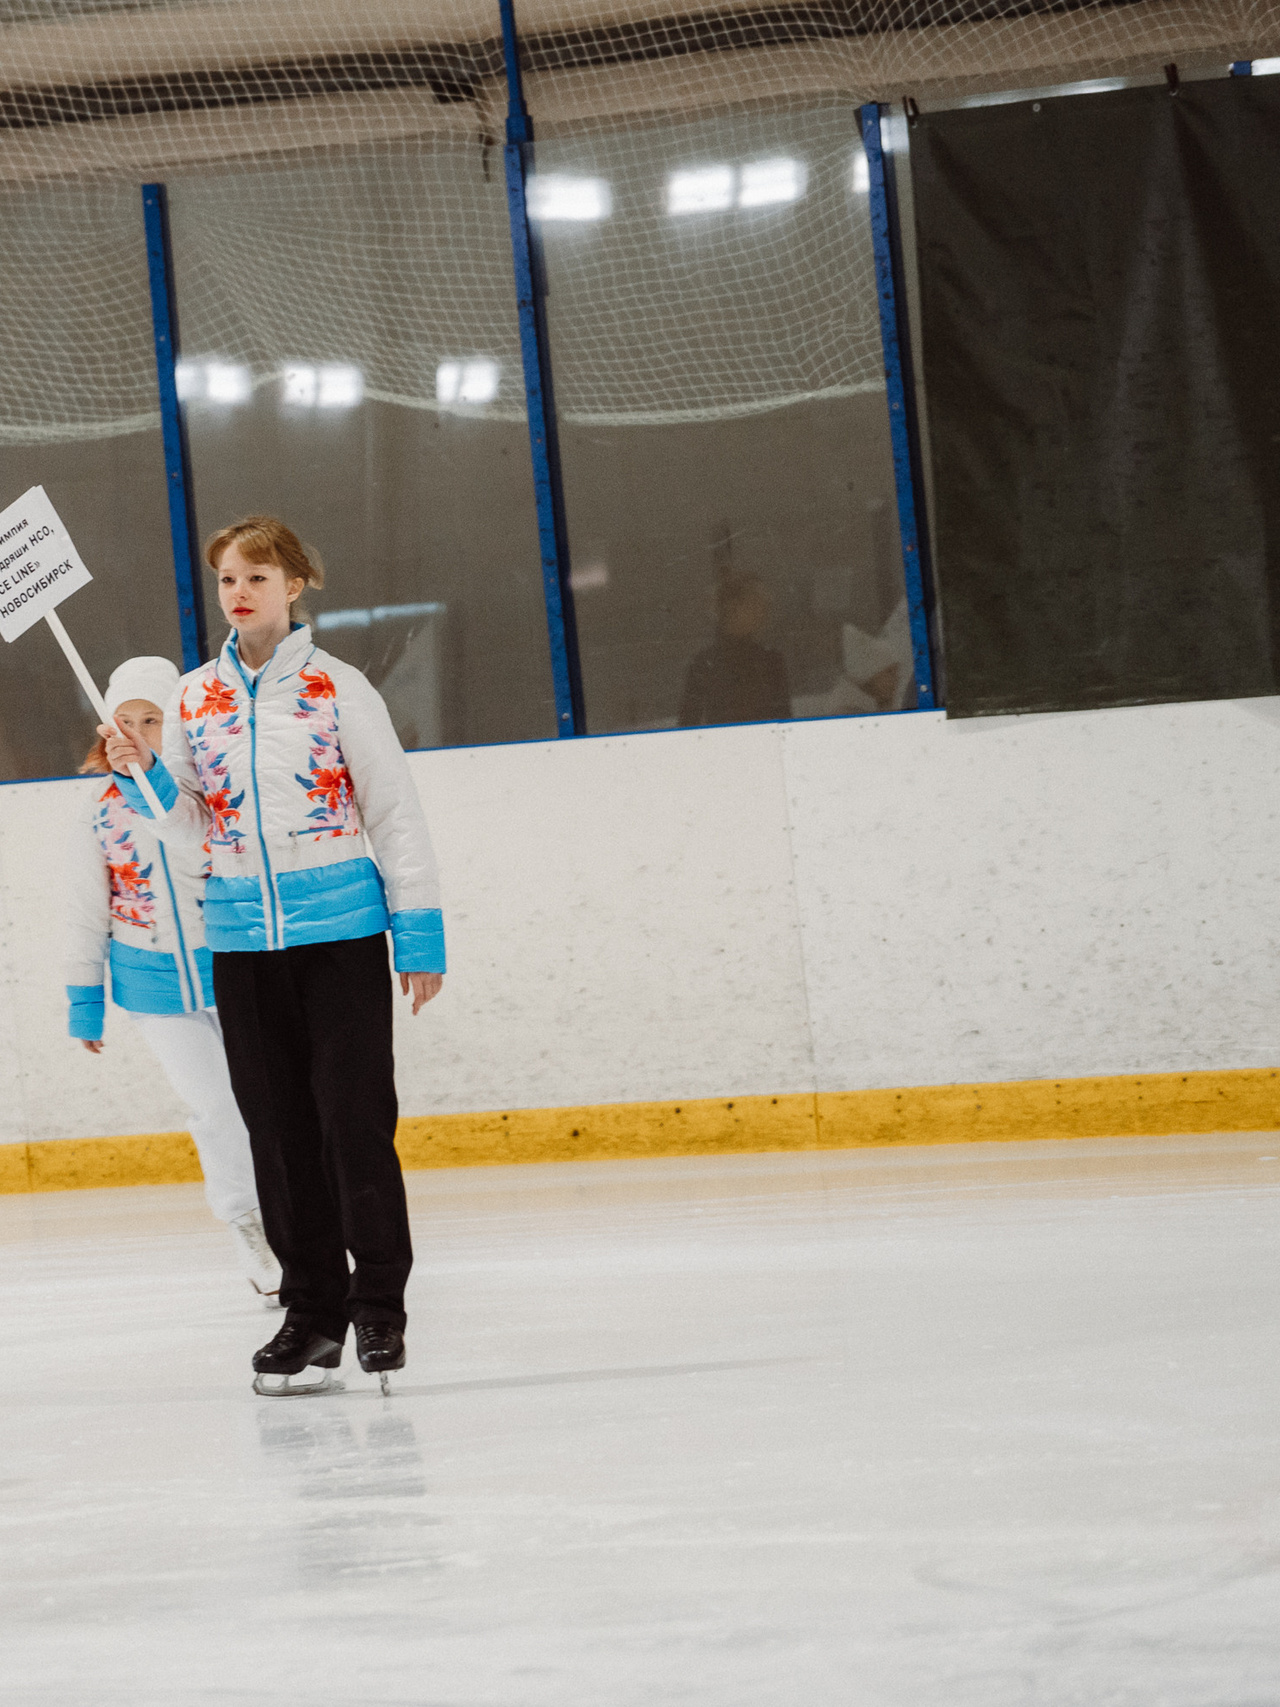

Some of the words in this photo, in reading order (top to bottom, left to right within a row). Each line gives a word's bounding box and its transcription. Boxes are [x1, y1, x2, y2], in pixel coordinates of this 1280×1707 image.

[28, 525, 55, 547] НСО,
[10, 561, 40, 584] LINE»
[0, 559, 74, 618] НОВОСИБИРСК
